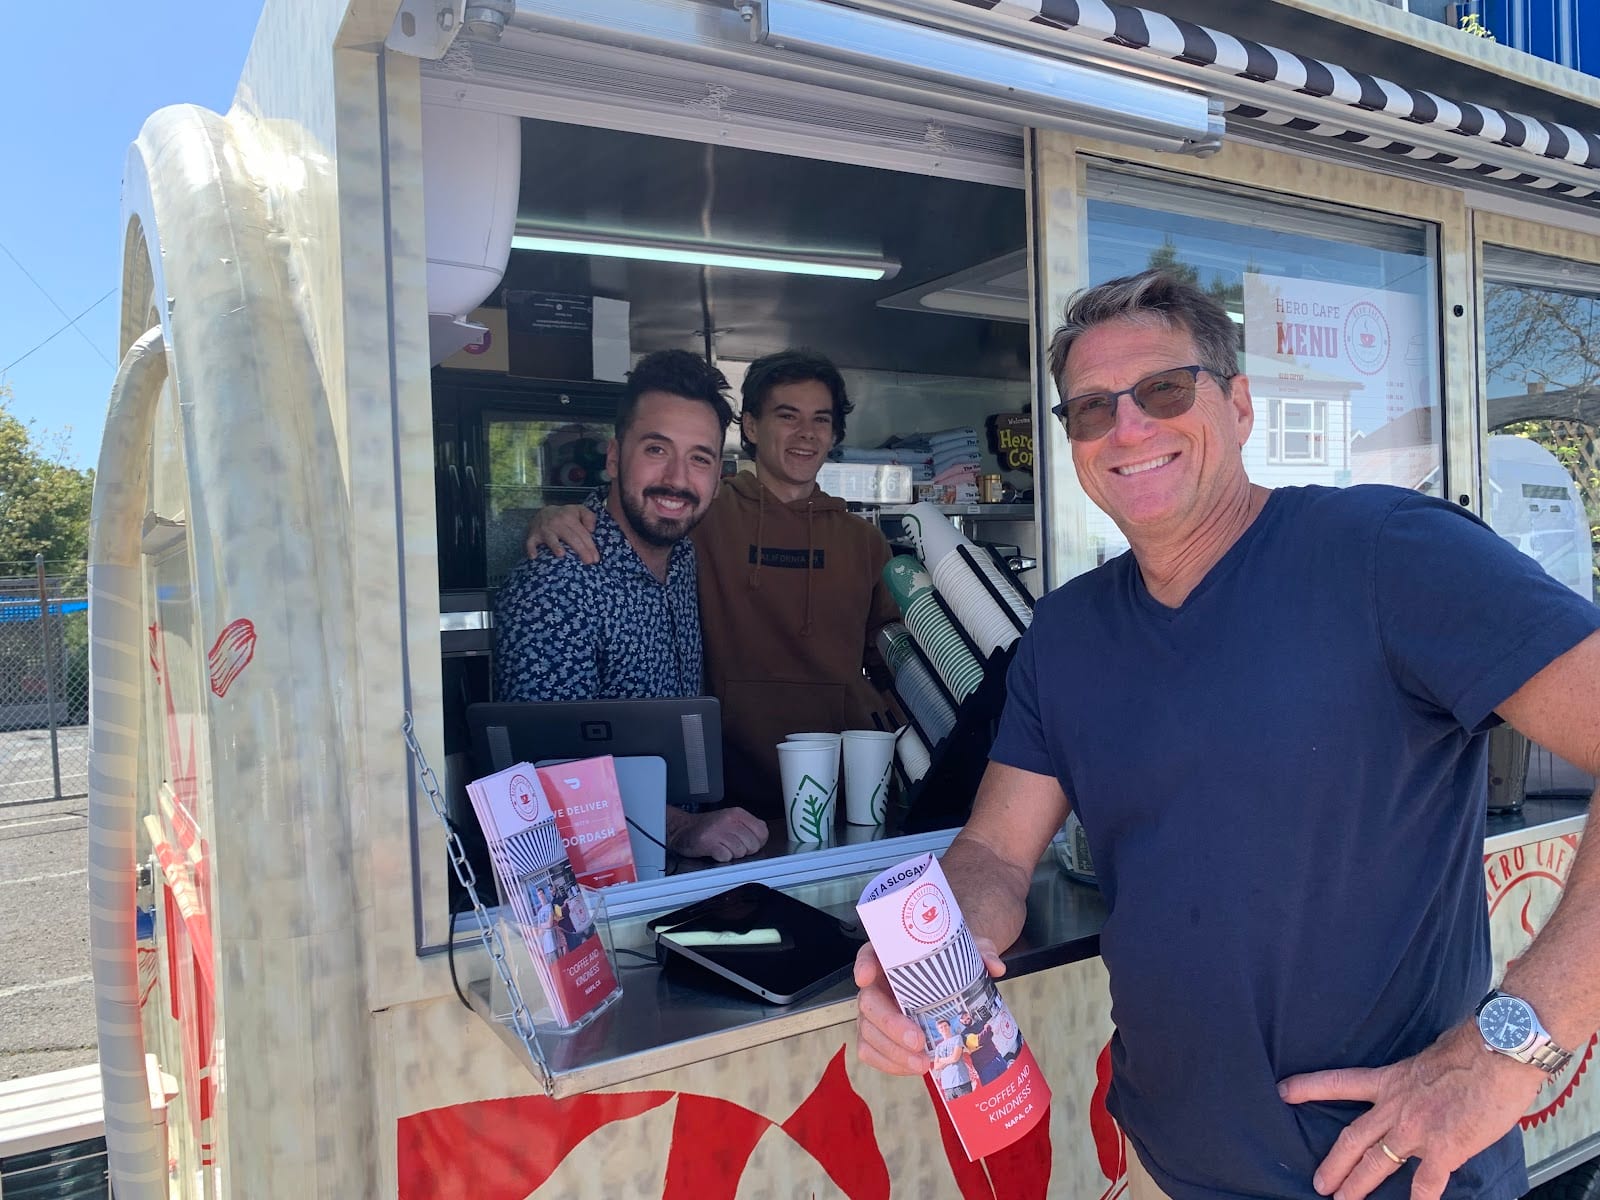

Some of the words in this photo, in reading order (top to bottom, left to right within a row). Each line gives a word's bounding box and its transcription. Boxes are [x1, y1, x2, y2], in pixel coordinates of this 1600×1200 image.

[1276, 298, 1308, 316] HERO
[1276, 321, 1338, 359] MENU
[567, 800, 609, 815] DELIVER
[562, 827, 617, 848] OORDASH
[1487, 846, 1525, 901] ERO
[880, 883, 888, 893] A
[975, 1082, 1017, 1112] "COFFEE
[1017, 1064, 1030, 1087] AND
[988, 1080, 1032, 1124] KINDNESS"
[1024, 1104, 1034, 1114] CA
